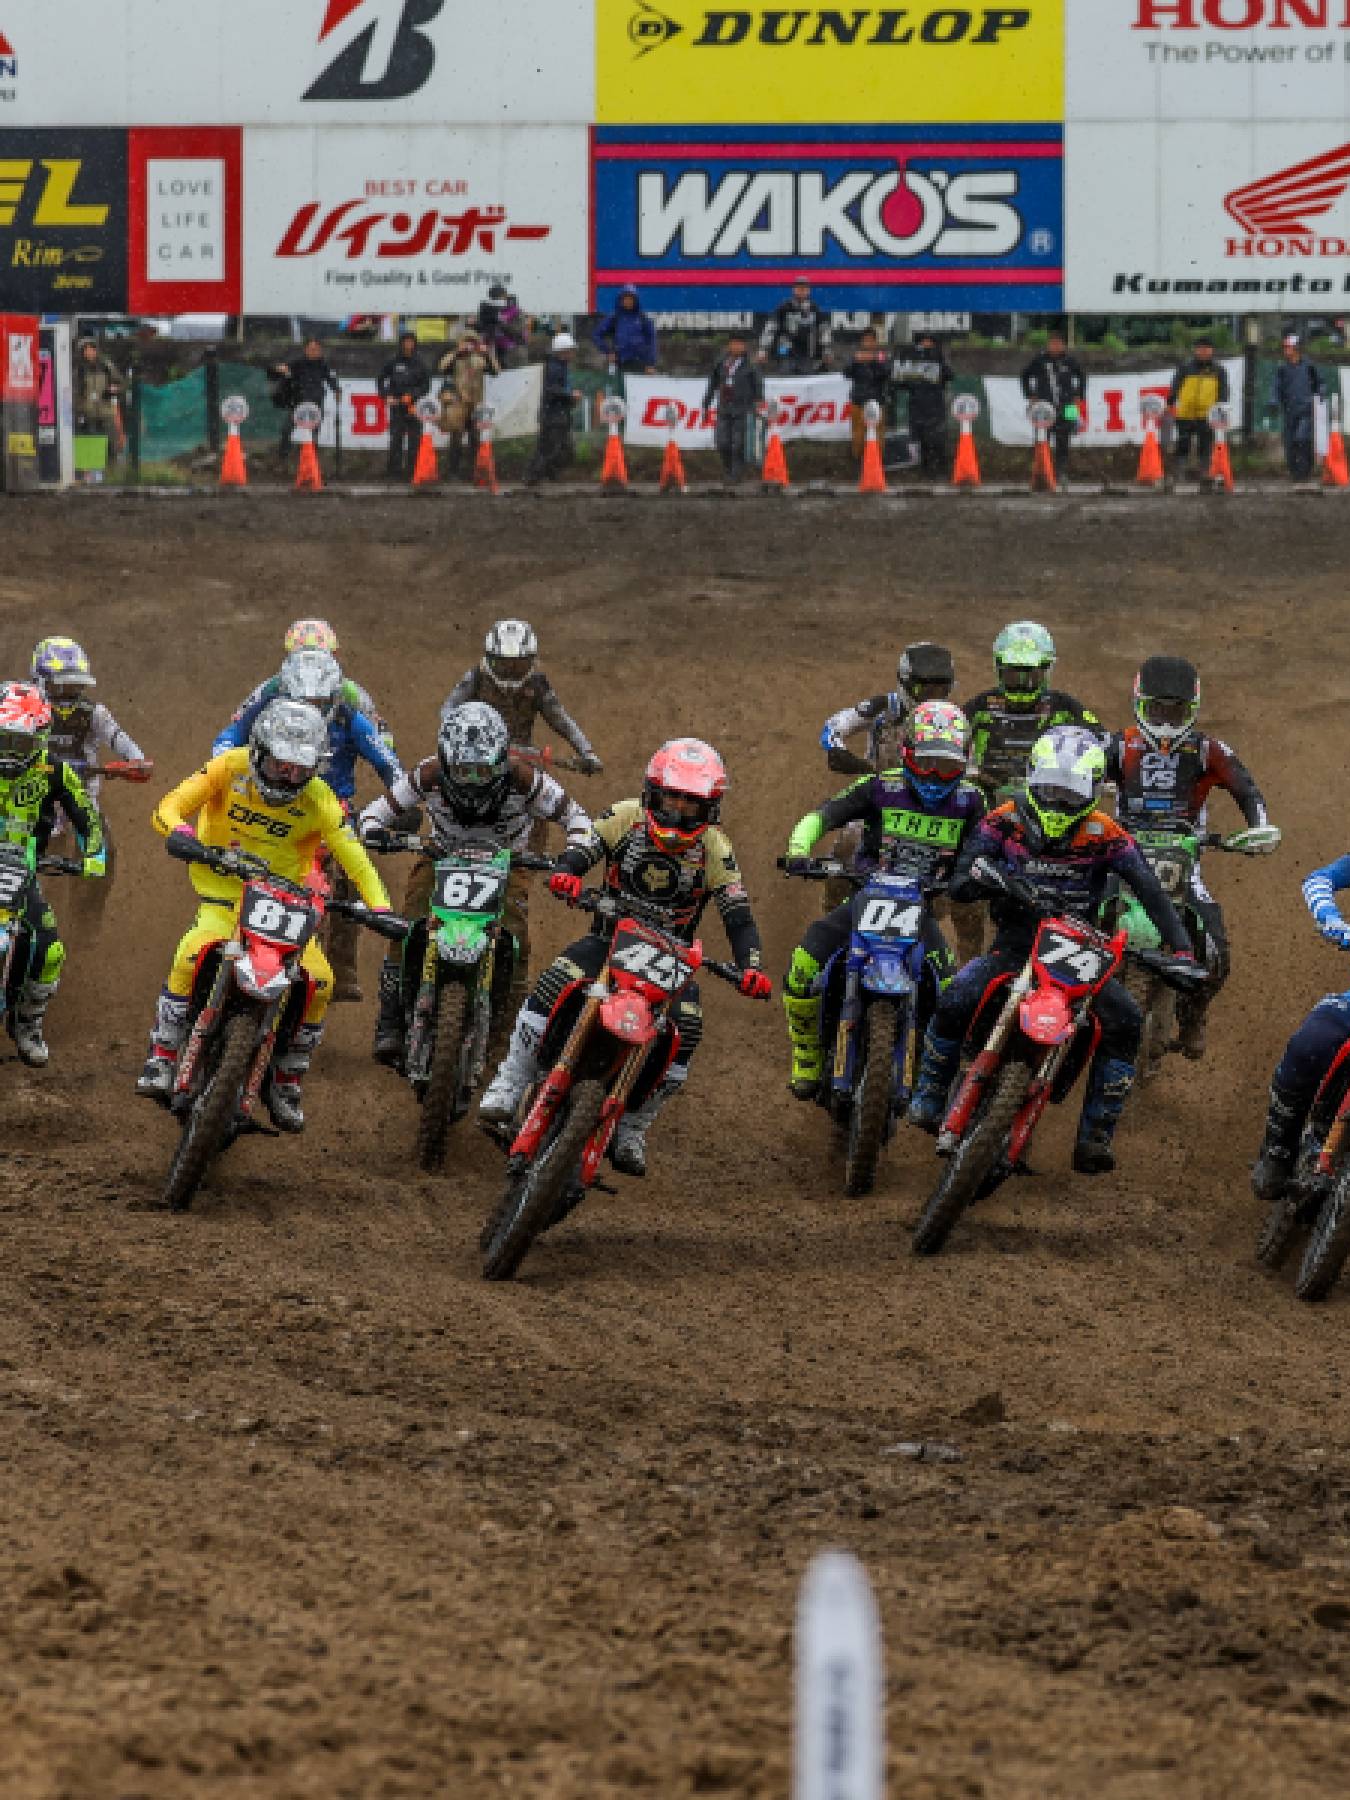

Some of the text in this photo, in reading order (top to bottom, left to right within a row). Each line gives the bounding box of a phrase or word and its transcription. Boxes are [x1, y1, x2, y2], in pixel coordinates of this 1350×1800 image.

[692, 9, 1031, 46] DUNLOP
[1144, 41, 1198, 63] The
[1205, 41, 1297, 63] Power
[1303, 41, 1335, 63] of
[157, 180, 213, 196] LOVE
[364, 180, 468, 196] BEST CAR
[160, 212, 209, 229] LIFE
[274, 197, 552, 259] レインボー
[158, 244, 214, 260] CAR
[325, 270, 357, 286] Fine
[361, 270, 413, 288] Quality
[432, 270, 471, 286] Good
[1112, 272, 1333, 294] Kumamoto
[442, 872, 500, 908] 67
[248, 899, 307, 941] 81
[857, 900, 921, 935] 04
[1038, 934, 1100, 983] 74
